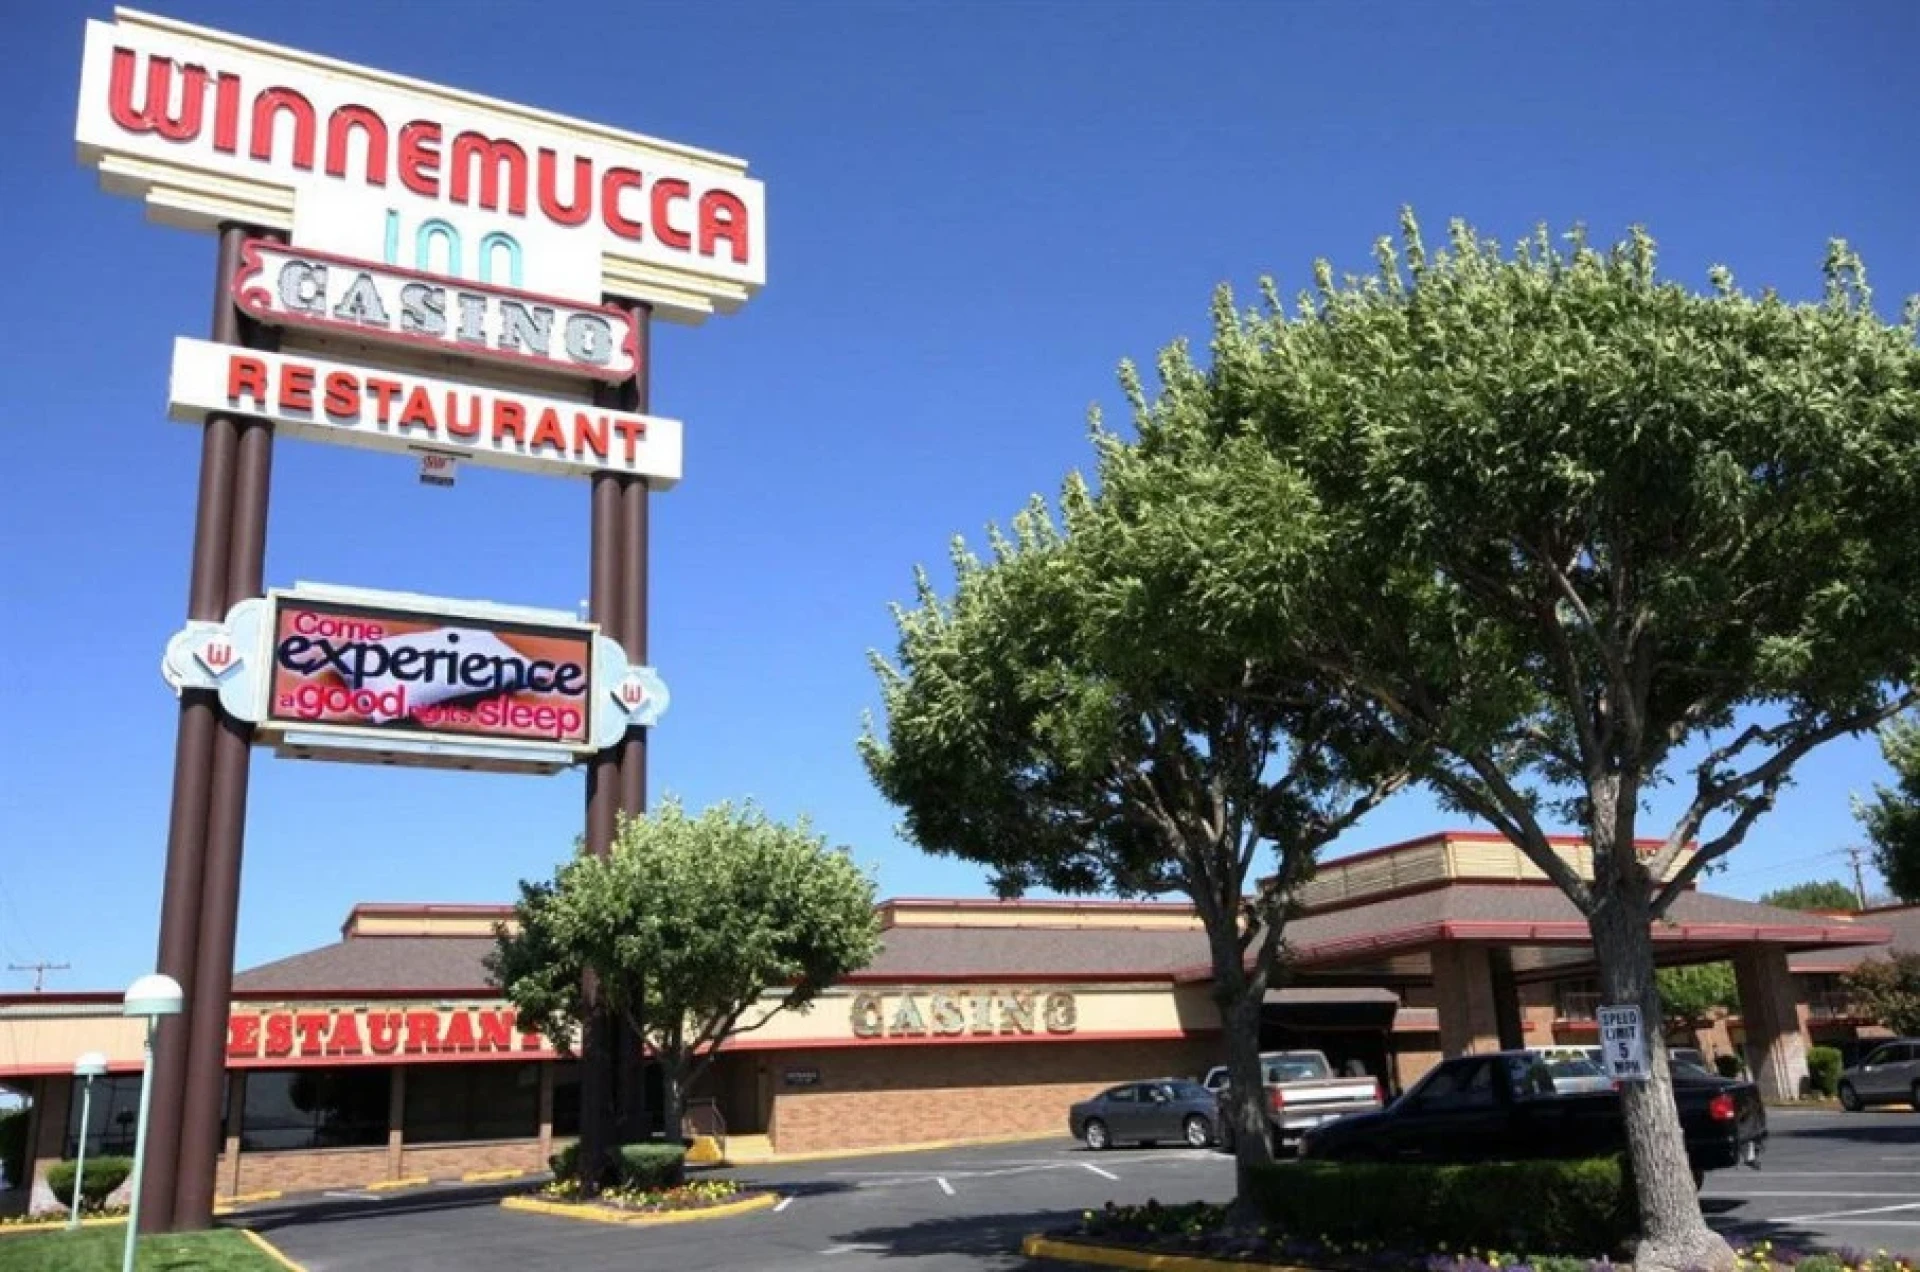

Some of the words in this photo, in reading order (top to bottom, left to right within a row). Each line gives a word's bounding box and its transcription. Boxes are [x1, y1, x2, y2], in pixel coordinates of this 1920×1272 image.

[108, 46, 748, 264] WINNEMUCCA
[278, 260, 615, 366] CASINO
[227, 354, 646, 463] RESTAURANT
[294, 612, 384, 641] Come
[277, 633, 588, 696] experience
[297, 684, 407, 719] good
[477, 693, 581, 738] sleep
[228, 1010, 540, 1058] ESTAURAN
[849, 991, 1077, 1039] CASINO
[1602, 1010, 1637, 1026] SPEED
[1605, 1025, 1635, 1041] LIMIT
[1614, 1061, 1640, 1074] MPH
[1618, 1042, 1629, 1059] 5
